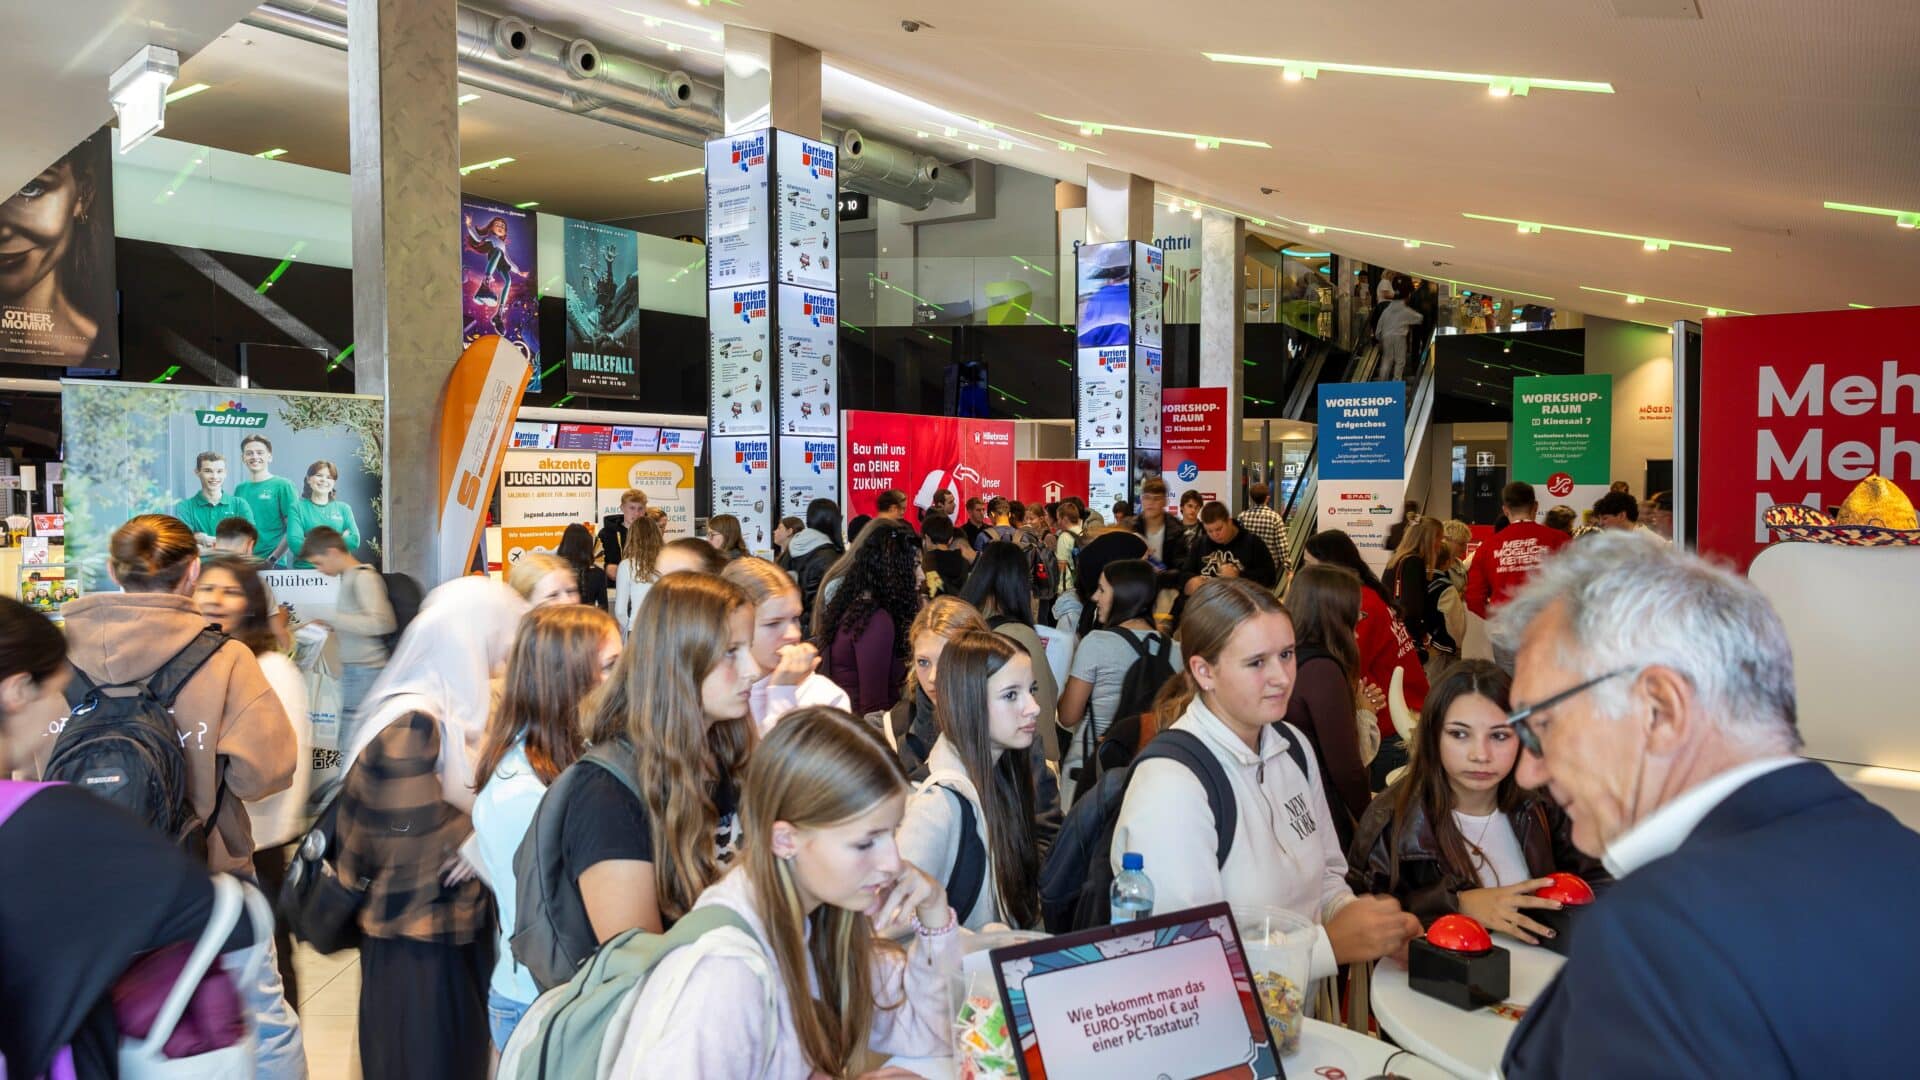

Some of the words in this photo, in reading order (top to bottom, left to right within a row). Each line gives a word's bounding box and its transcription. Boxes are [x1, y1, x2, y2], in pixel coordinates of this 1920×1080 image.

[732, 137, 763, 151] Karriere
[803, 143, 833, 160] Karriere
[847, 200, 857, 210] 10
[734, 290, 766, 302] Karriere
[804, 293, 834, 306] Karriere
[5, 311, 51, 323] OTHER
[1, 319, 55, 331] MOMMY
[572, 352, 635, 375] WHALEFALL
[1326, 397, 1397, 408] WORKSHOP-
[1522, 392, 1603, 403] WORKSHOP-
[1344, 408, 1379, 417] RAUM
[1542, 404, 1582, 414] RAUM
[202, 414, 263, 426] Dehner
[1173, 414, 1204, 422] RAUM
[1336, 421, 1387, 430] Erdgeschoss
[735, 440, 767, 451] Karriere
[805, 440, 835, 452] Karriere
[853, 443, 871, 455] Bau
[874, 443, 888, 454] mit
[890, 445, 906, 455] uns
[538, 457, 591, 469] akzente
[853, 462, 866, 472] an
[869, 461, 900, 472] DEINER
[507, 472, 591, 485] JUGENDINFO
[853, 478, 893, 490] ZUKUNFT
[982, 478, 1000, 488] Unser
[1503, 538, 1537, 548] MEHR
[1284, 792, 1307, 821] NEW
[1290, 811, 1316, 840] YORK
[1067, 1007, 1093, 1024] Wie
[1095, 993, 1154, 1017] bekommt
[1157, 987, 1183, 1003] man
[1185, 980, 1206, 995] das
[1083, 1004, 1168, 1037] EURO-Symbol
[1170, 1001, 1179, 1015] €
[1181, 995, 1199, 1011] auf
[1092, 1034, 1124, 1053] einer
[1127, 1012, 1200, 1044] PC-Tastatur?
